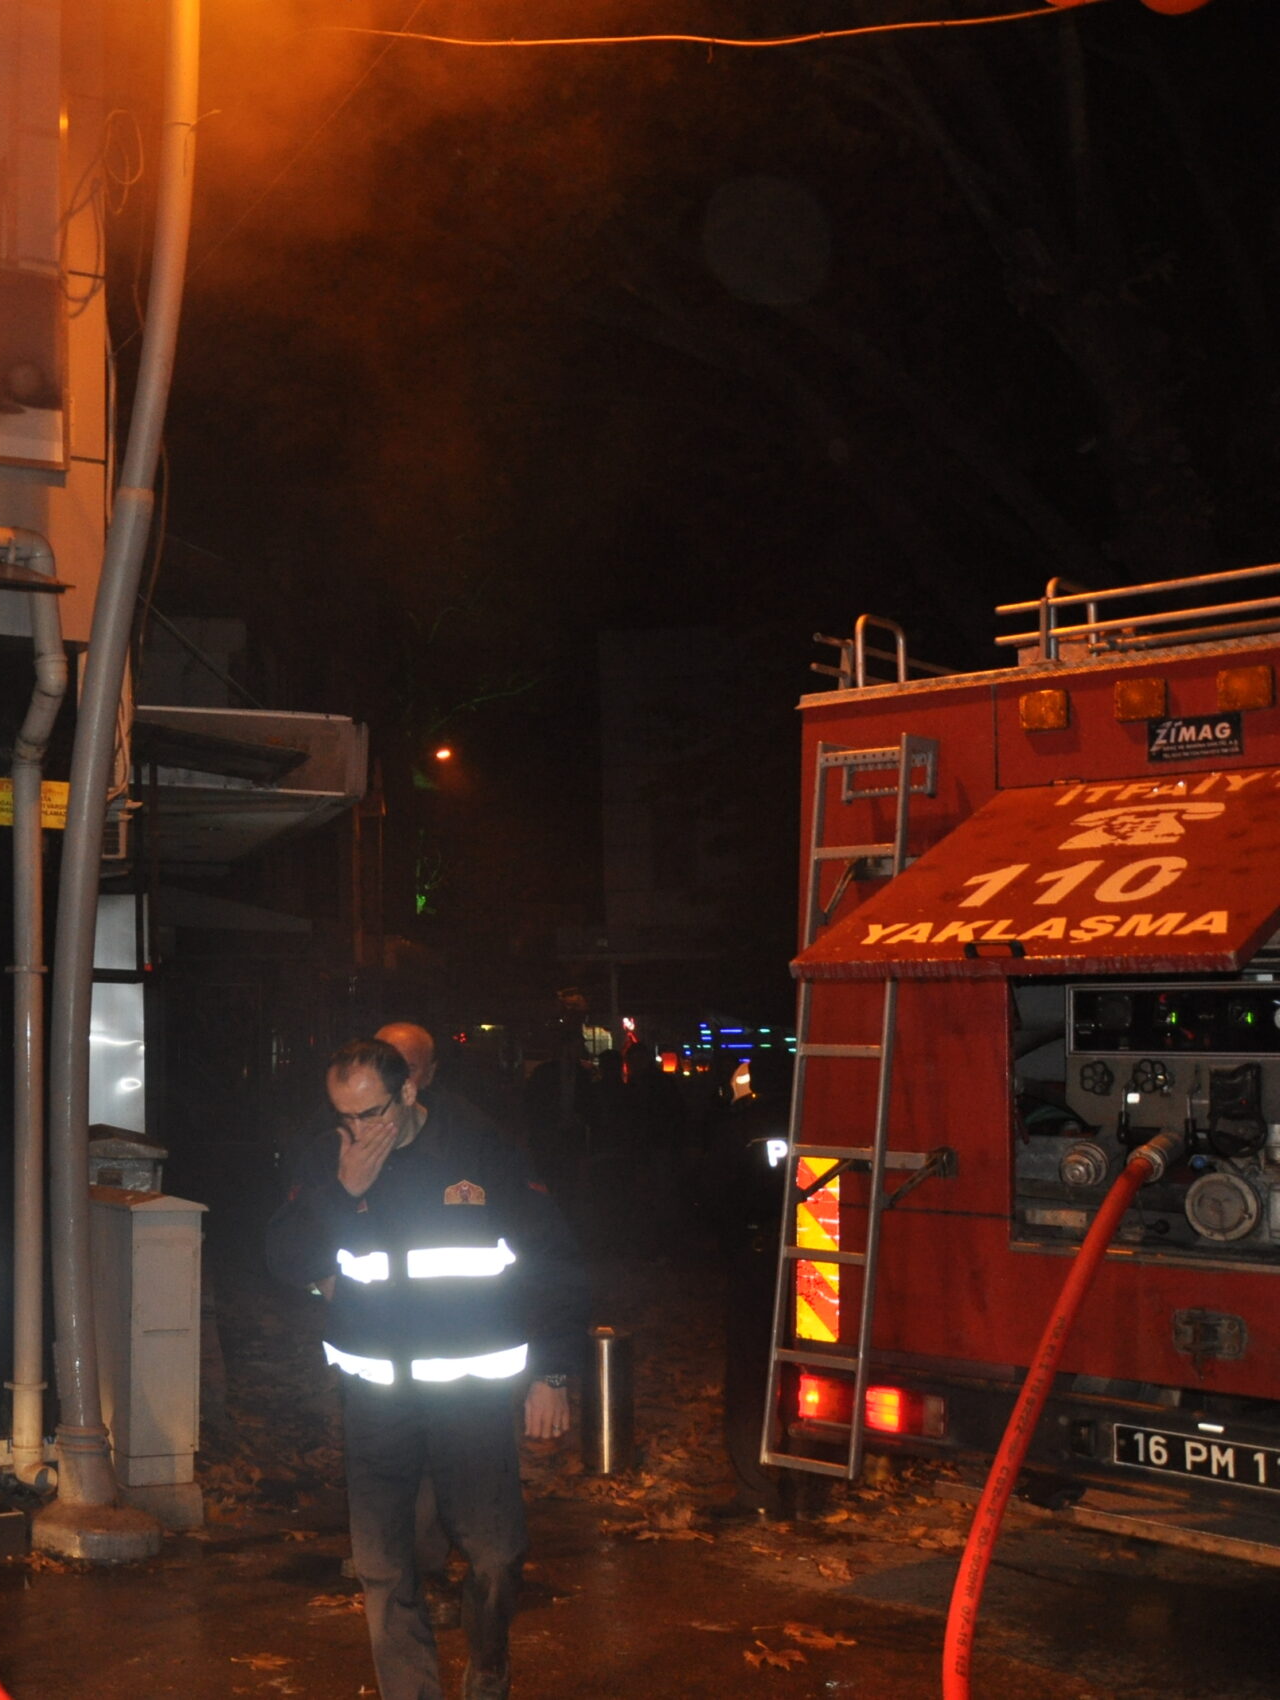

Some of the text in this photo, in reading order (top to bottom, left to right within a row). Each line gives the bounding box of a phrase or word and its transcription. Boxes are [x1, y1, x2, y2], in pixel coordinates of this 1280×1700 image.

[958, 857, 1188, 908] 110
[860, 911, 1228, 944] YAKLAŞMA
[1133, 1432, 1280, 1483] 16 PM 1
